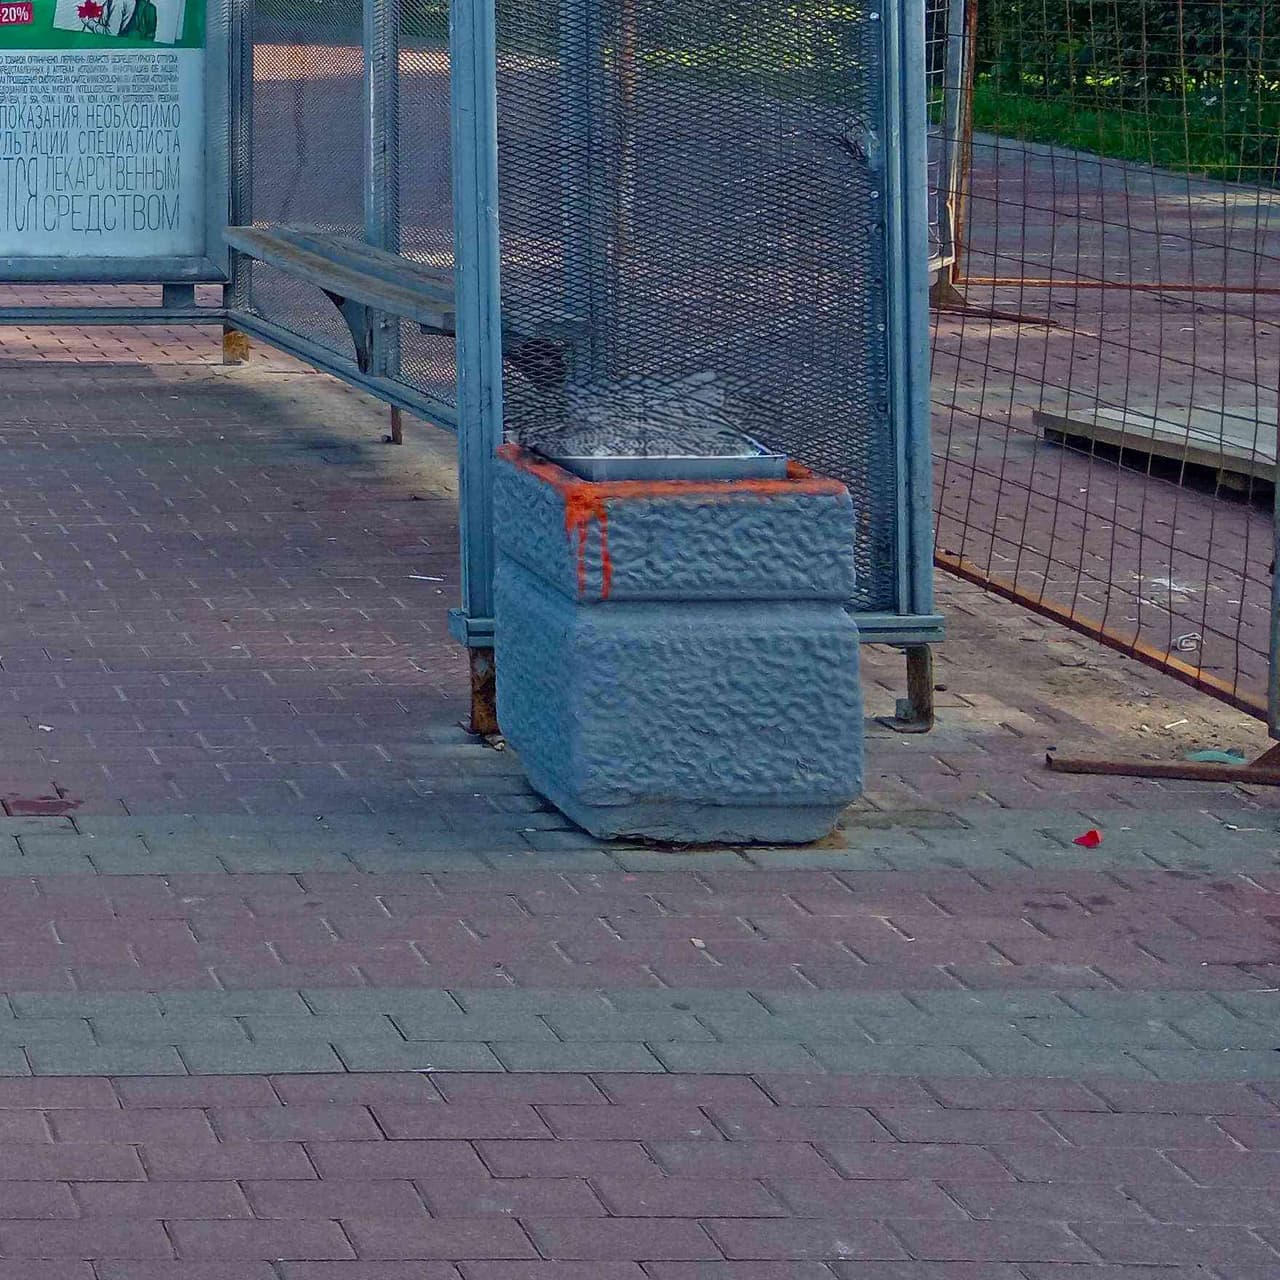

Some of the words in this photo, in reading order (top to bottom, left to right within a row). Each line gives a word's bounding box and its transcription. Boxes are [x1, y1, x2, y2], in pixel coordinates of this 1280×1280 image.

[86, 103, 181, 129] НЕОБХОДИМО
[79, 130, 181, 156] СПЕЦИАЛИСТА
[45, 156, 180, 191] ЛЕКАРСТВЕННЫМ
[43, 194, 180, 236] СРЕДСТВОМ
